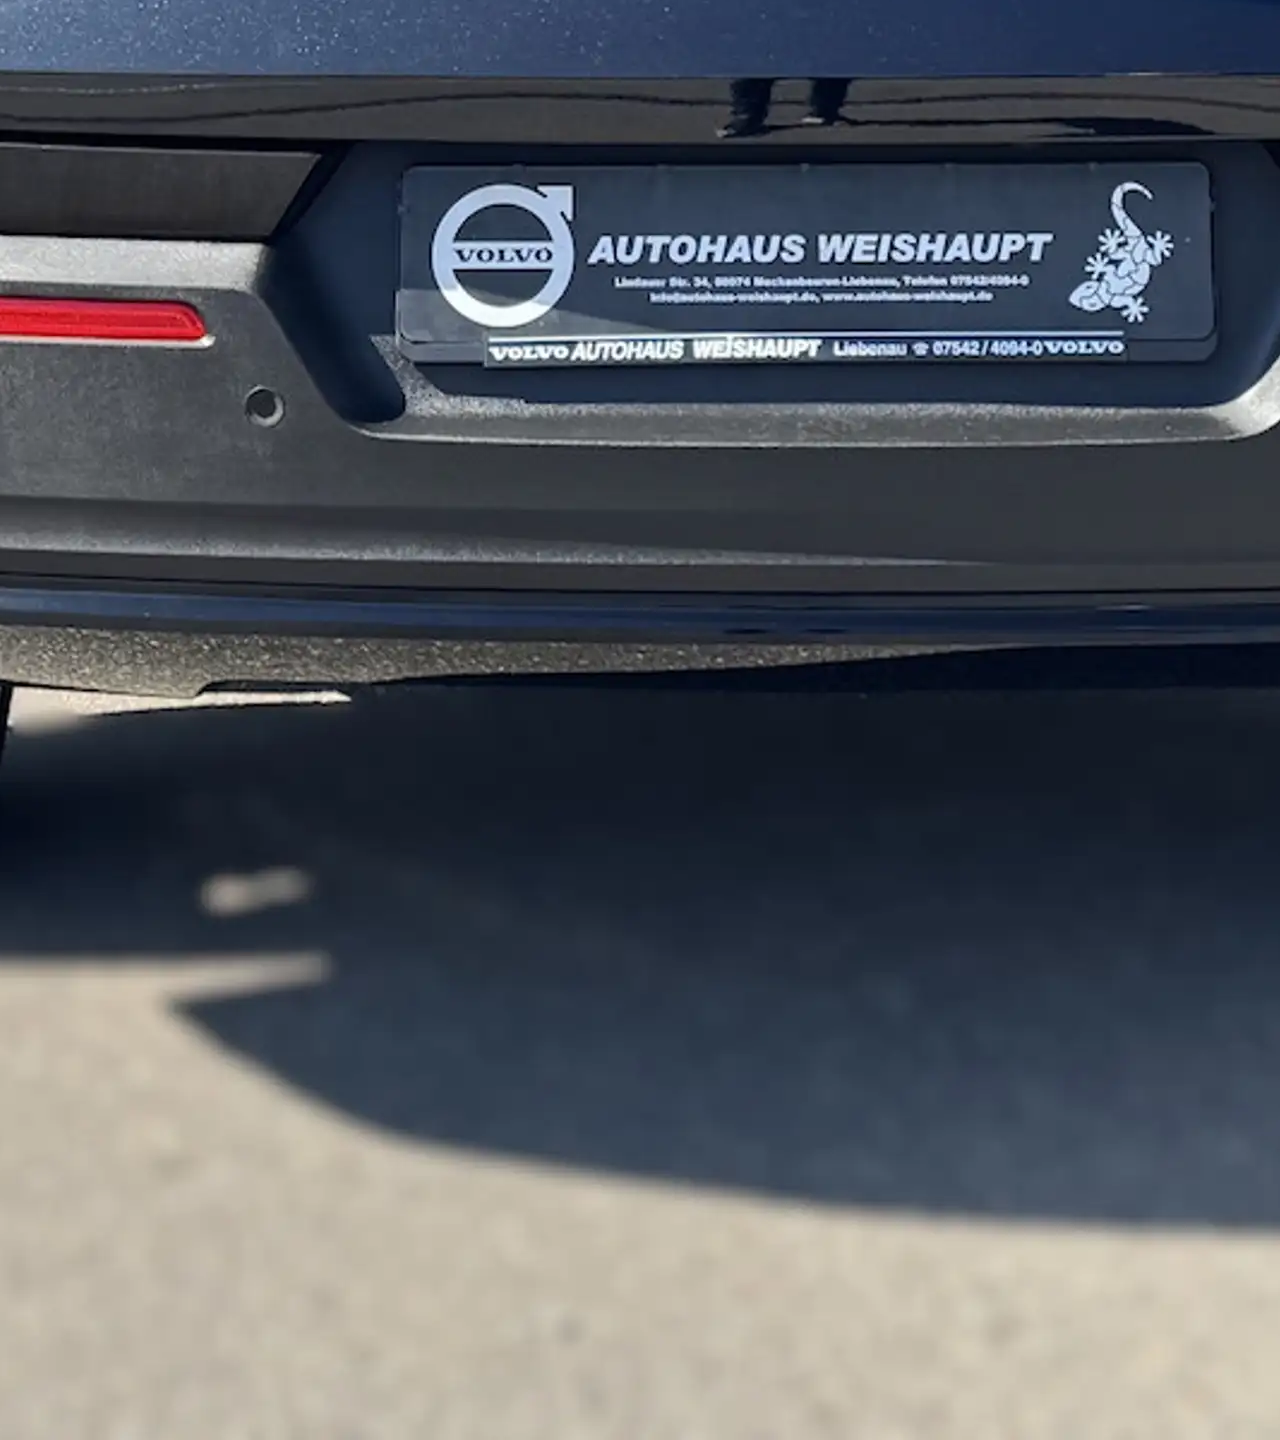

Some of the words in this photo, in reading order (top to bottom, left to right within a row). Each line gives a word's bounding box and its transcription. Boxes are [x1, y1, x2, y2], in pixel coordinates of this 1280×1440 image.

[454, 246, 554, 263] VOLVO
[587, 234, 806, 264] AUTOHAUS
[817, 233, 1054, 263] WEISHAUPT
[489, 345, 569, 361] VOLVO
[570, 340, 684, 361] AUTOHAUS
[692, 337, 822, 359] WEISHAUPT
[833, 340, 908, 357] Liebenau
[1044, 340, 1125, 355] VOLVO
